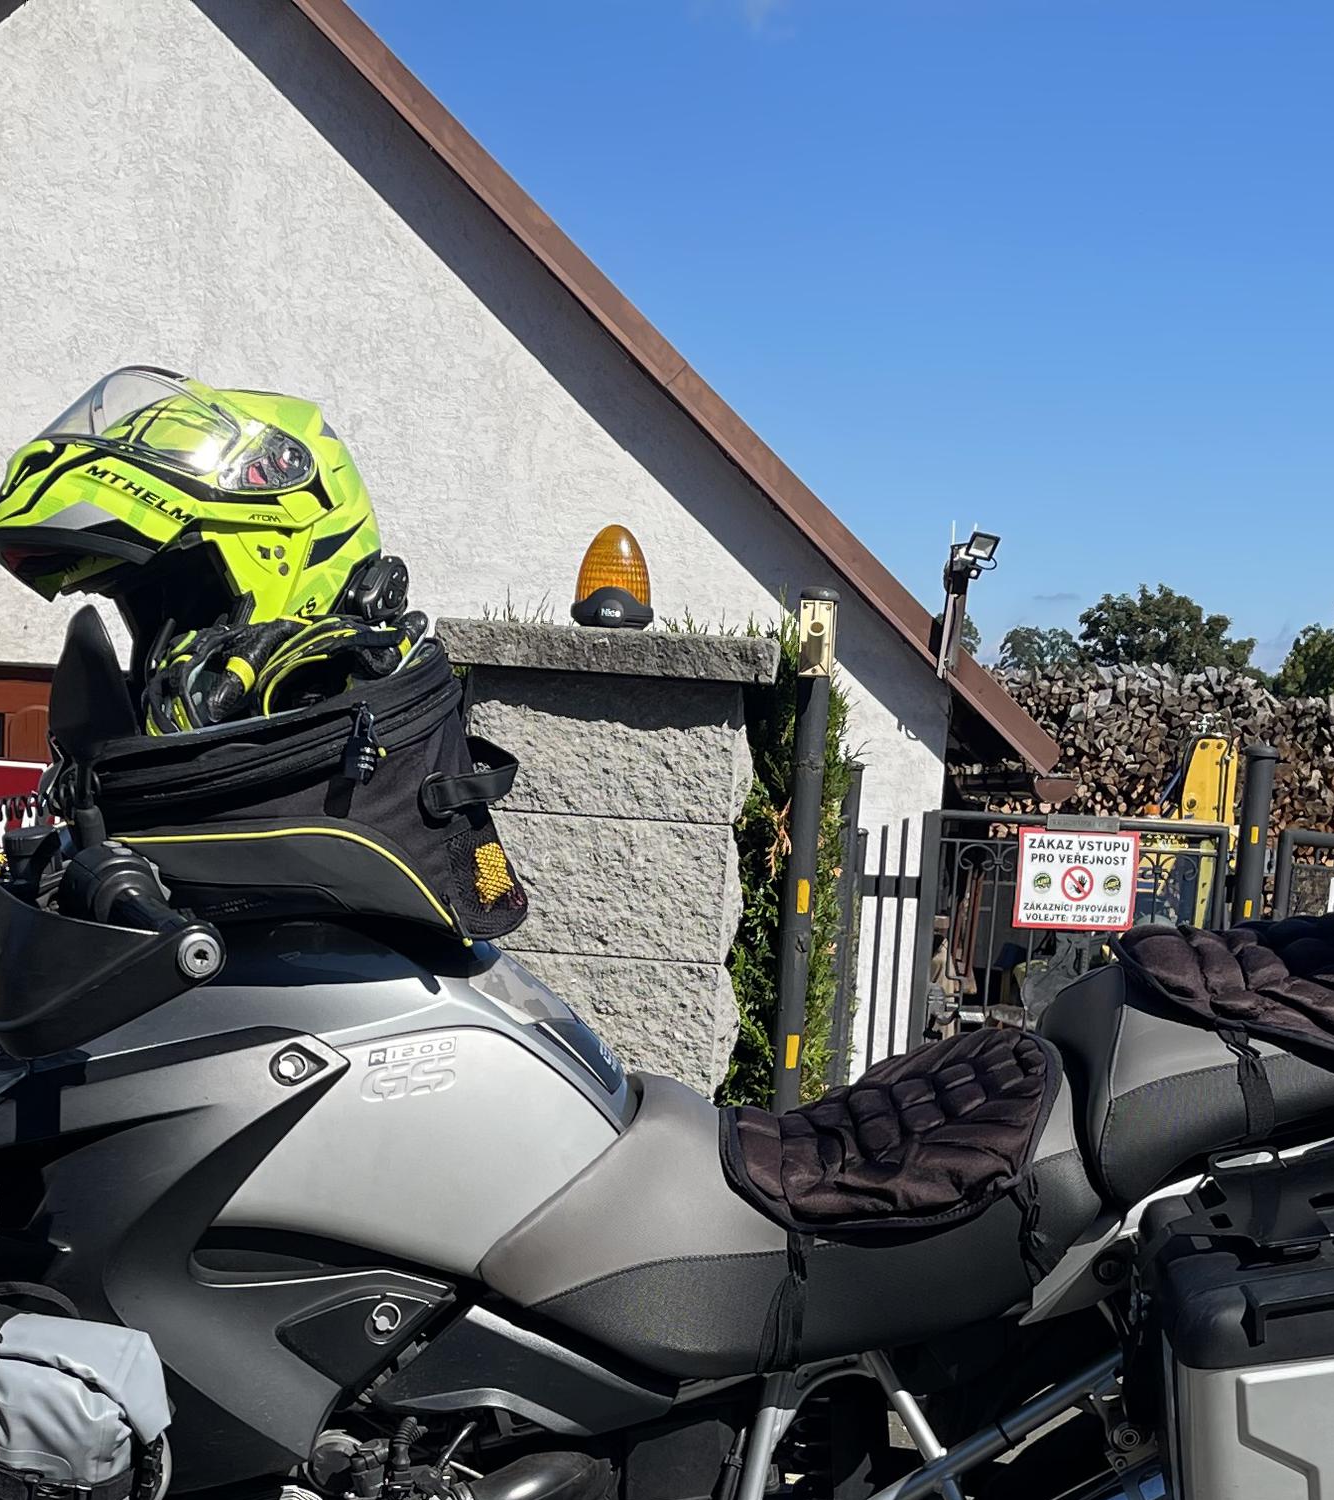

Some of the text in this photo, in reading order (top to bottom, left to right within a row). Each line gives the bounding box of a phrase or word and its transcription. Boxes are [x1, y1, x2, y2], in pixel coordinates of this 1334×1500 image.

[248, 513, 282, 523] ATOM
[601, 607, 621, 618] Nice
[1028, 836, 1130, 852] ZÁKAZ VSTUPU
[1031, 852, 1127, 866] PRO VEŘEJNOST
[1023, 902, 1073, 912] ZÁKAZNÍCI
[360, 1055, 457, 1102] GS
